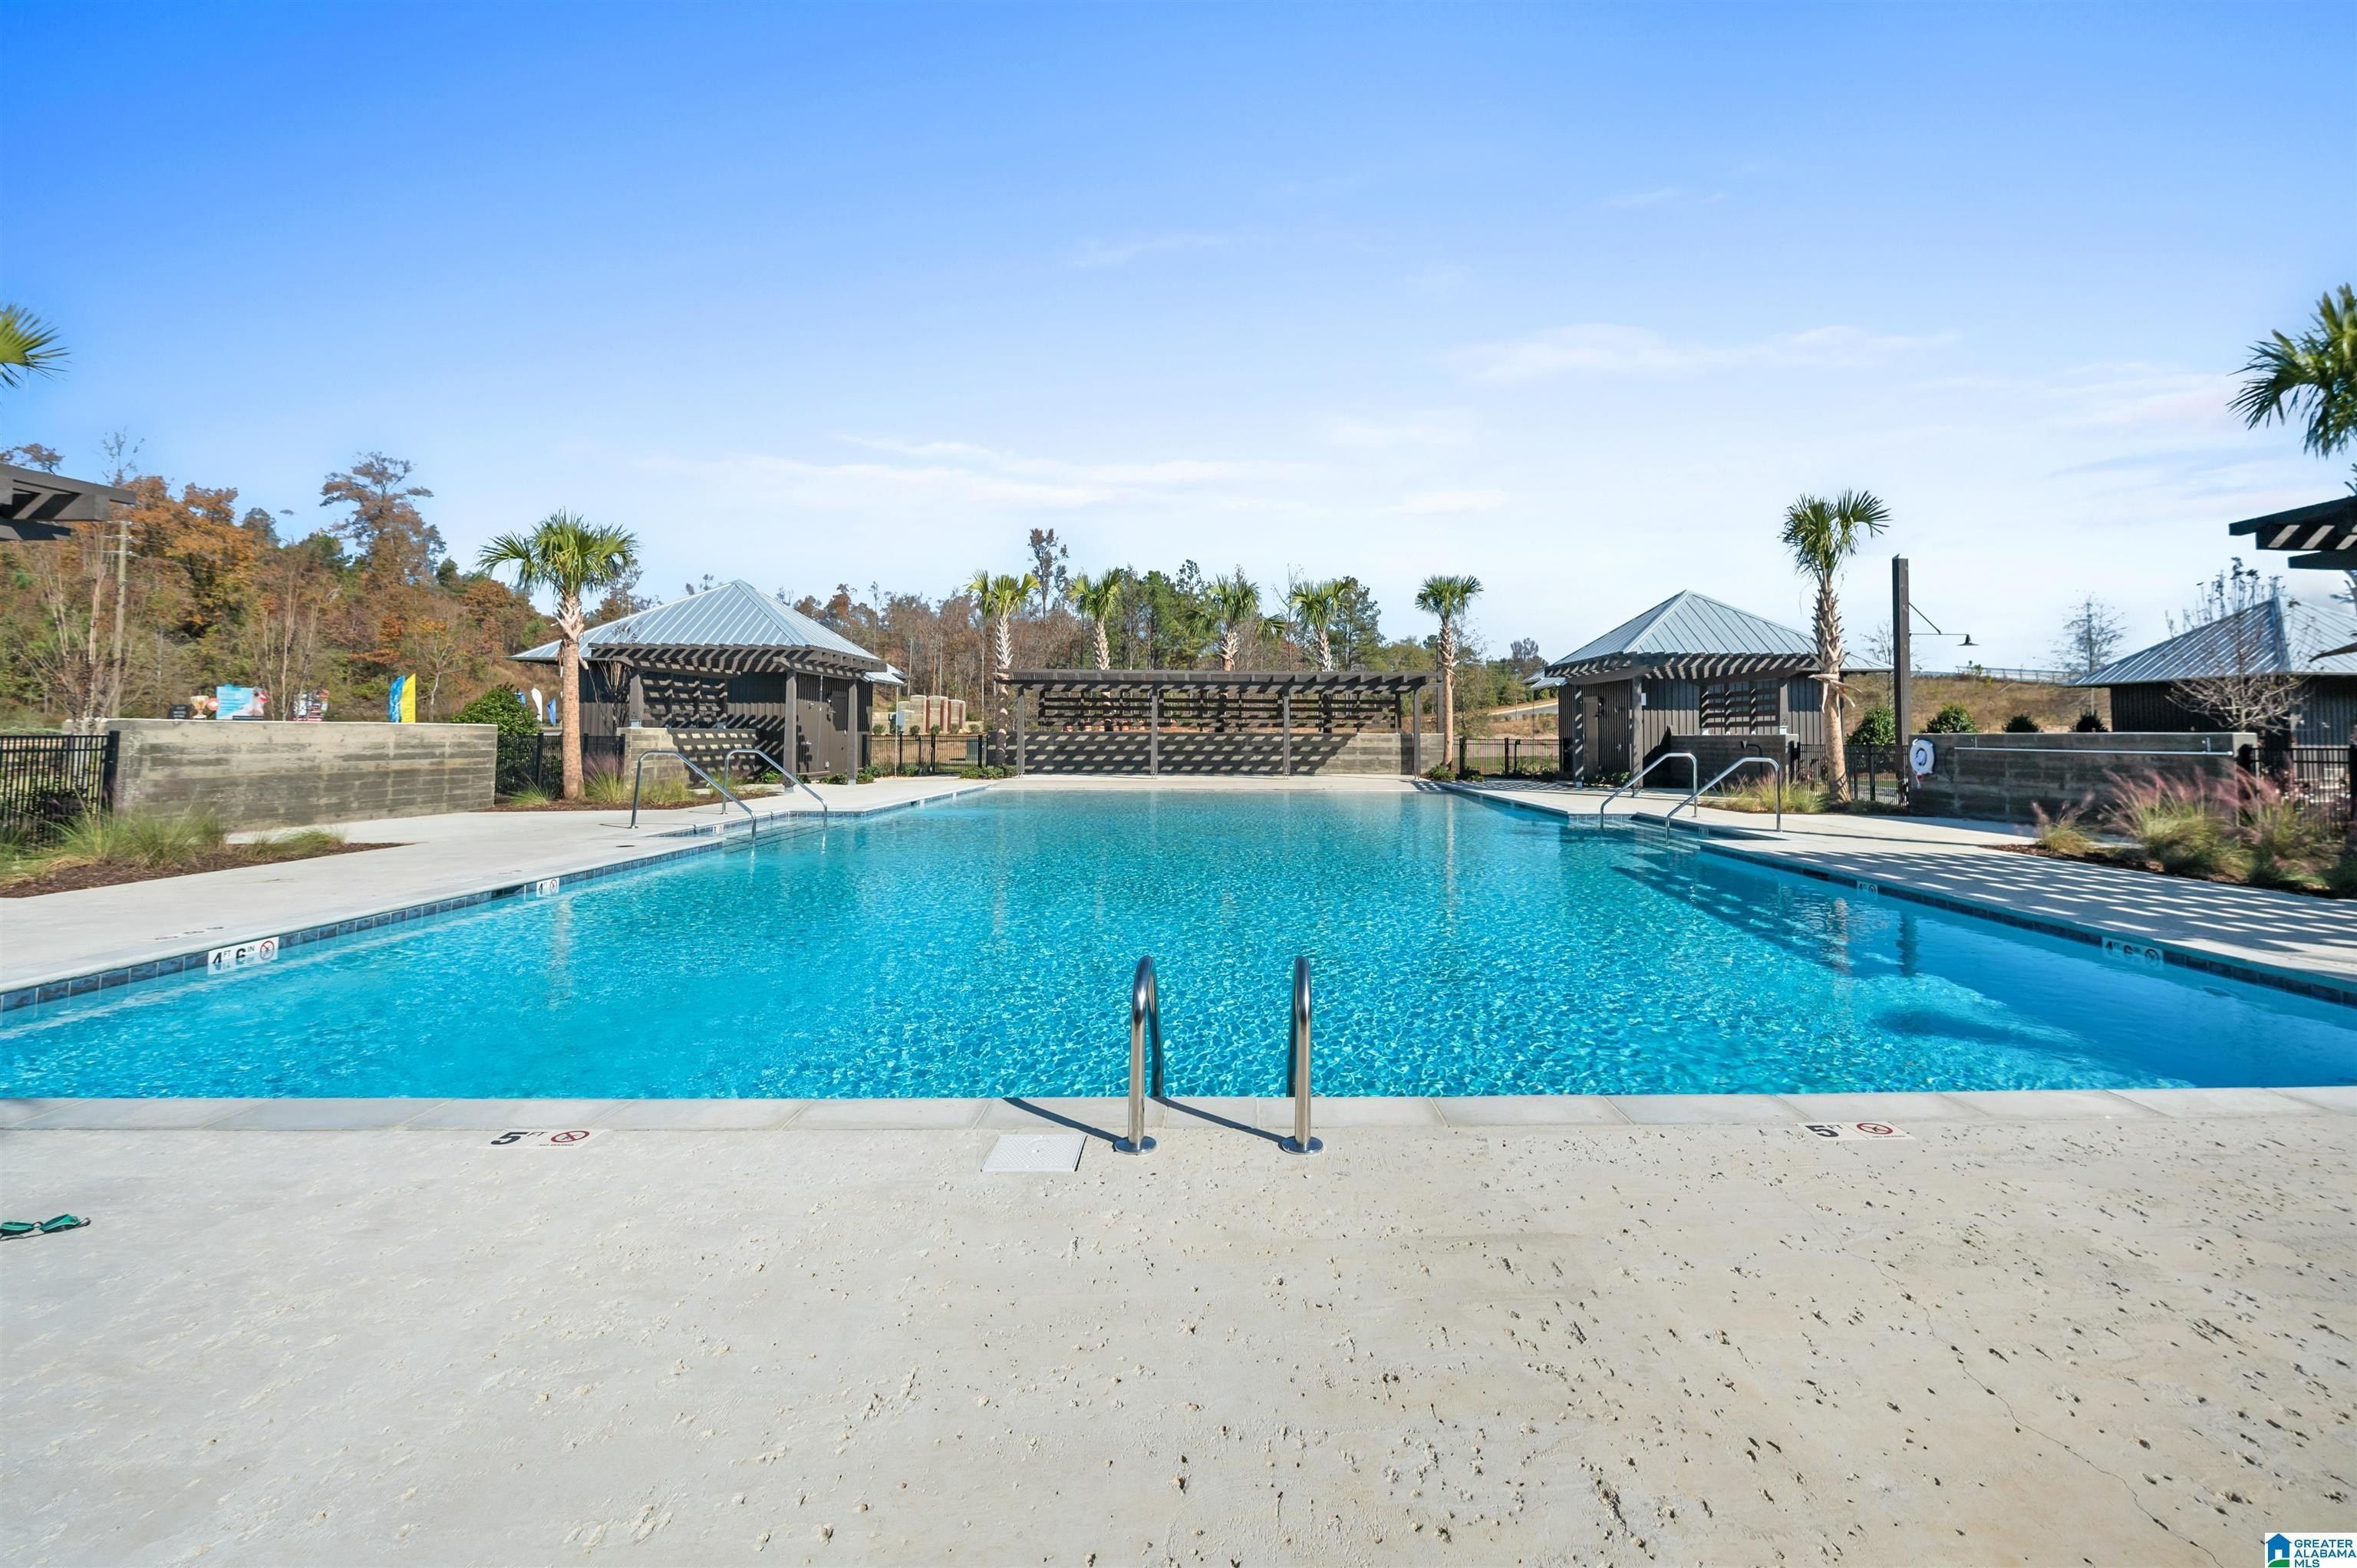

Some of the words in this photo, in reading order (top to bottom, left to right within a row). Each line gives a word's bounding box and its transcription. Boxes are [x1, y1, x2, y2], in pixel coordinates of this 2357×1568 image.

[2105, 941, 2112, 950] 4
[213, 952, 222, 964] 4
[236, 948, 246, 959] 6
[1805, 1125, 1839, 1137] 5
[491, 1132, 529, 1145] 5
